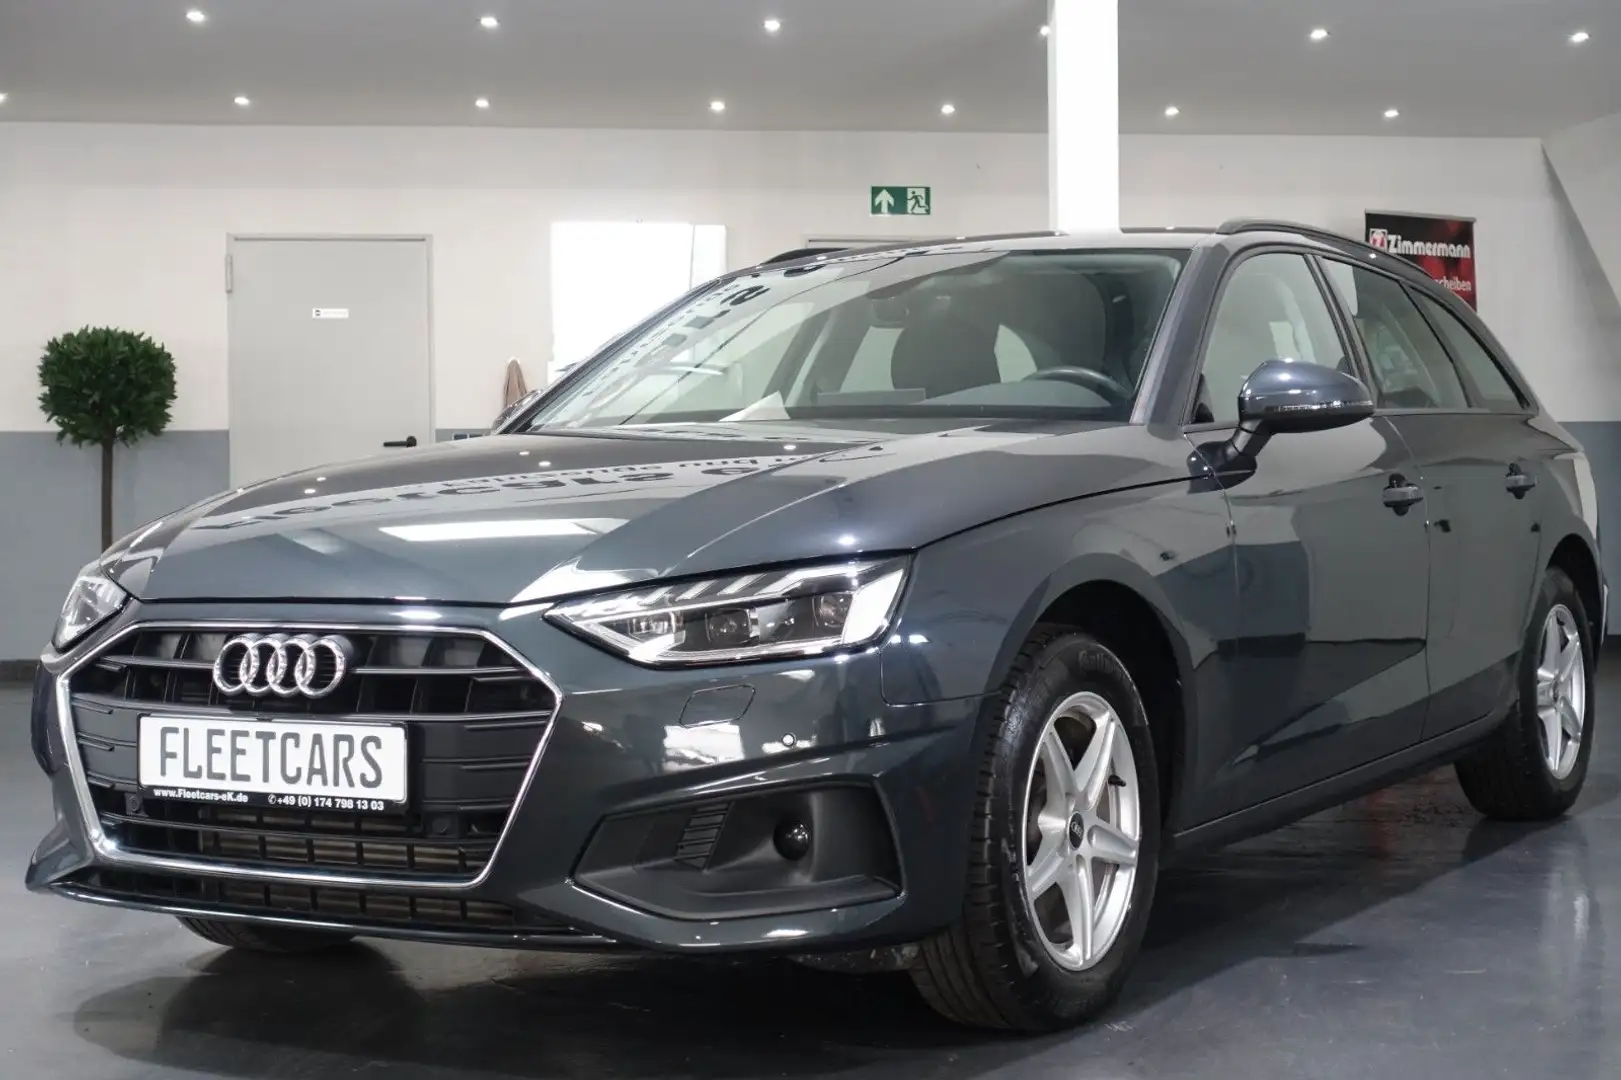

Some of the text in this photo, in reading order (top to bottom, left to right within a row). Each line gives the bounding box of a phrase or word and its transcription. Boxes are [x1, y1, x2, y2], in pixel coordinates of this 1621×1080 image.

[1388, 234, 1470, 258] Zimmermann
[160, 727, 383, 788] FLEETCARS
[153, 788, 249, 802] www.Fleetcars-eK.de
[297, 795, 312, 807] (0)
[314, 797, 332, 808] 174
[335, 798, 354, 809] 798
[356, 799, 368, 810] 13
[370, 800, 385, 811] 03
